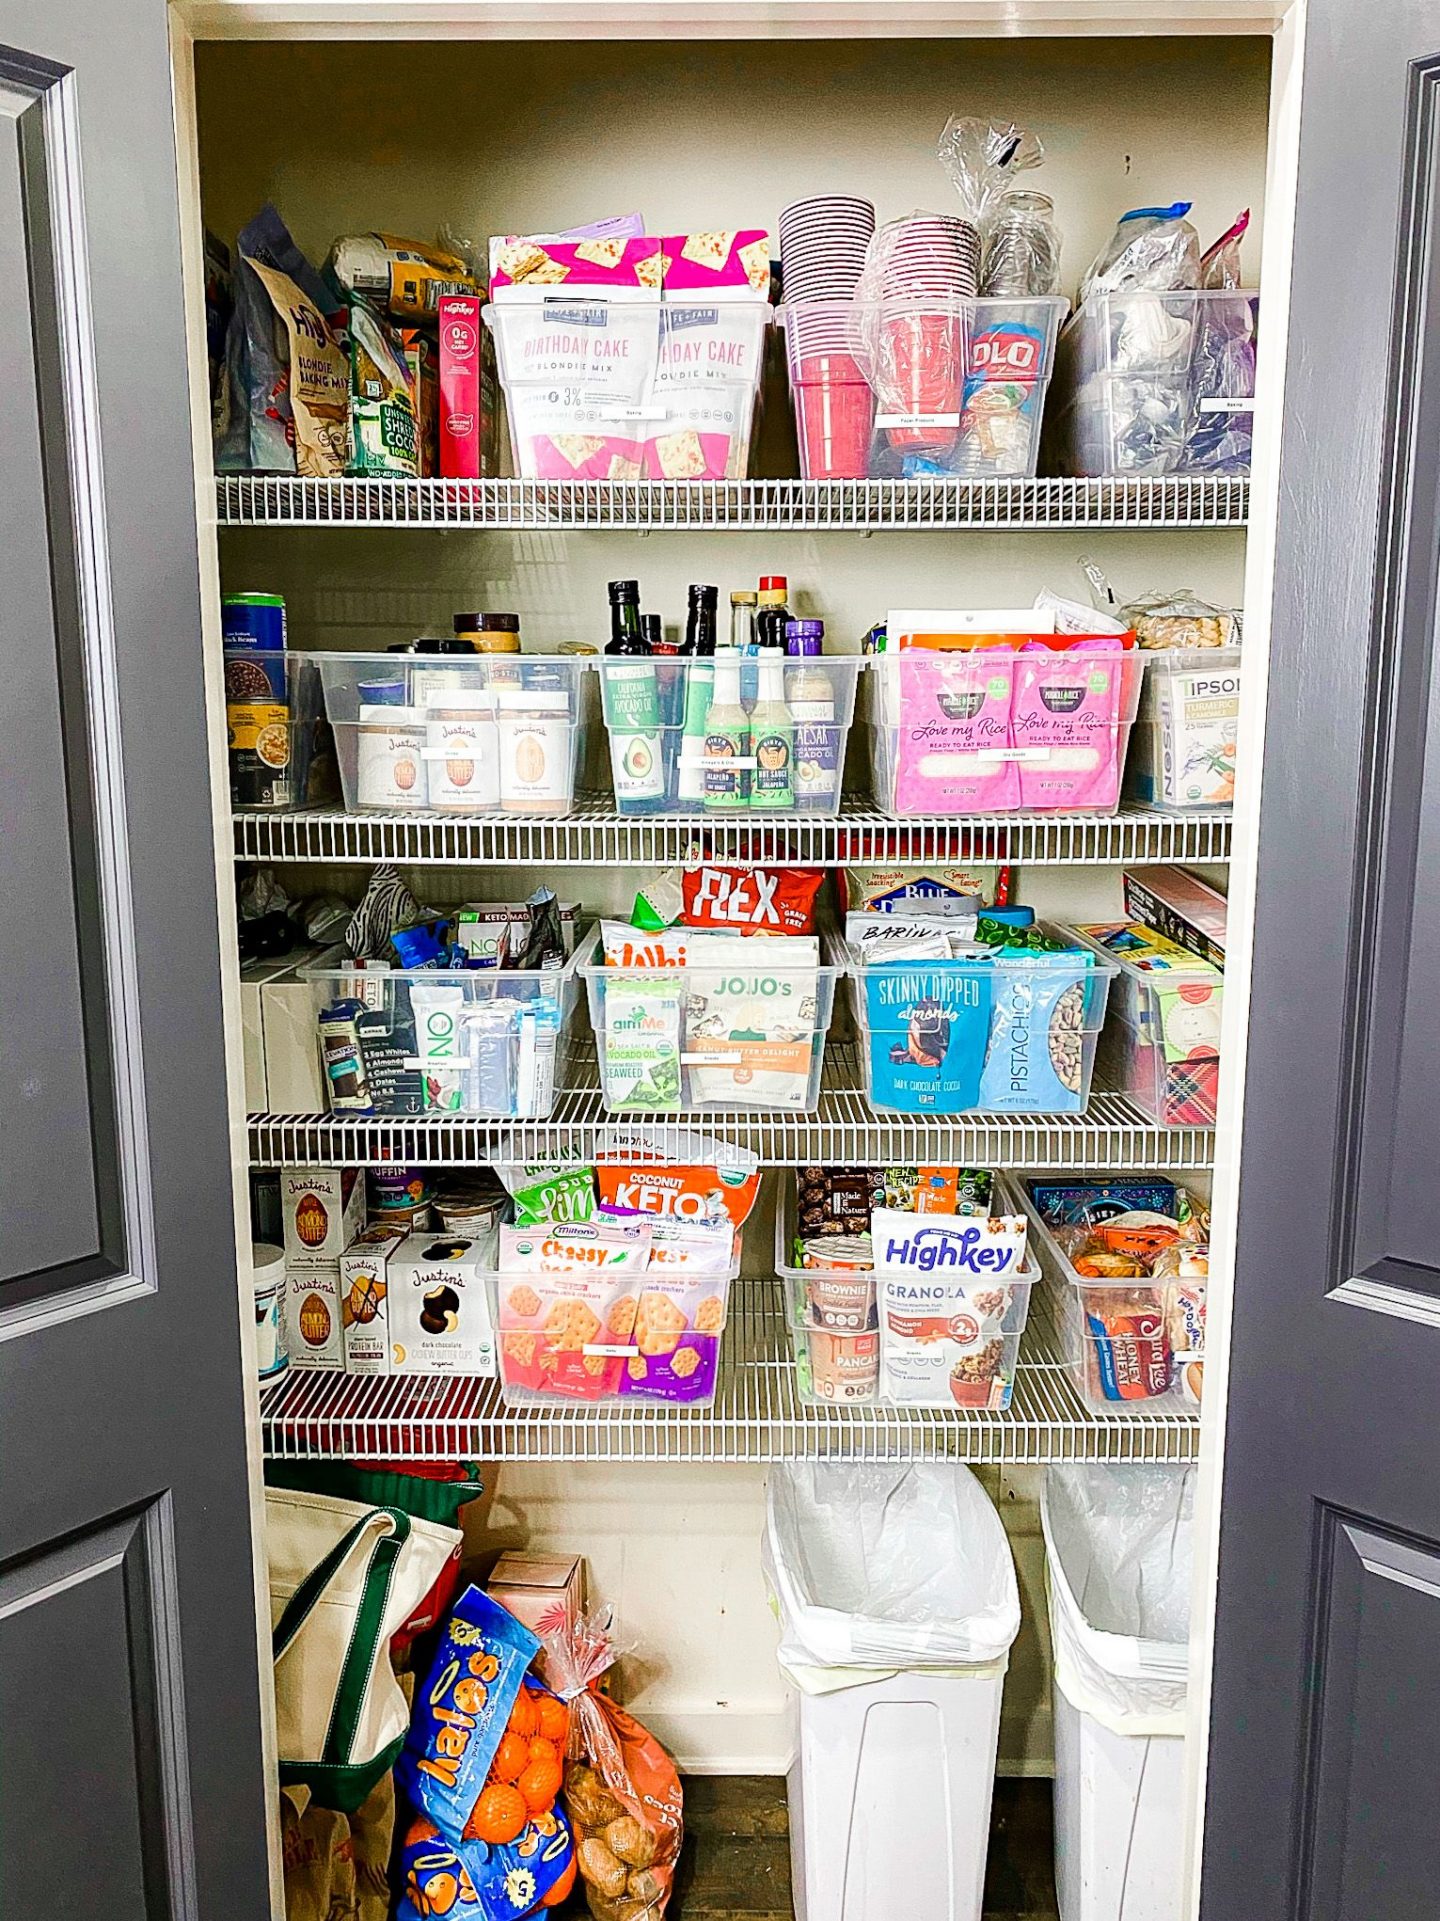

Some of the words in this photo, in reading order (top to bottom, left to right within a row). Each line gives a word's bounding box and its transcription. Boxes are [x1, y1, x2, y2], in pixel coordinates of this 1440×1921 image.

[523, 334, 588, 358] BIRTHDAY
[594, 339, 629, 358] CAKE
[708, 340, 745, 366] CAKE
[592, 364, 613, 372] MIX
[563, 386, 582, 407] 3%
[1186, 700, 1235, 713] TURMERIC
[1017, 711, 1048, 732] Love
[442, 725, 477, 738] Justin's
[911, 719, 948, 741] Love
[951, 726, 974, 741] my
[977, 717, 1007, 737] Rice
[871, 872, 904, 880] Irresistible
[691, 867, 780, 925] FLEX
[485, 912, 508, 922] KETO
[784, 909, 807, 922] GRAIN
[785, 918, 803, 929] FREE
[994, 958, 1051, 969] Wonderful
[878, 975, 928, 1007] SKINNY
[931, 974, 980, 1008] DIPPED
[898, 1001, 960, 1022] almonds
[370, 1050, 385, 1058] Egg
[385, 1048, 411, 1056] Whites
[643, 1050, 656, 1059] OIL
[762, 1048, 801, 1057] DELIGHT
[605, 1067, 643, 1079] SEAWEED
[376, 1078, 397, 1086] Dates
[909, 1080, 942, 1092] CHOCOLATE
[288, 1178, 334, 1195] Justin's
[629, 1172, 685, 1188] COCONUT
[892, 1175, 925, 1188] RECIPE
[614, 1183, 706, 1219] KETO
[841, 1191, 861, 1200] Made
[841, 1206, 867, 1215] Nature
[1090, 1210, 1117, 1223] SIET
[557, 1224, 596, 1237] Milton's
[345, 1259, 379, 1273] Justin's
[412, 1267, 466, 1288] Justin's
[292, 1278, 336, 1295] Justin's
[819, 1281, 867, 1296] BROWNIE
[348, 1341, 371, 1351] PROTEIN
[372, 1341, 384, 1350] BAR
[421, 1341, 434, 1349] dark
[435, 1341, 462, 1349] chocolate
[1112, 1334, 1131, 1387] WHEAT
[1123, 1332, 1142, 1385] HONEY
[1147, 1363, 1167, 1393] Lee
[417, 1651, 502, 1788] halos
